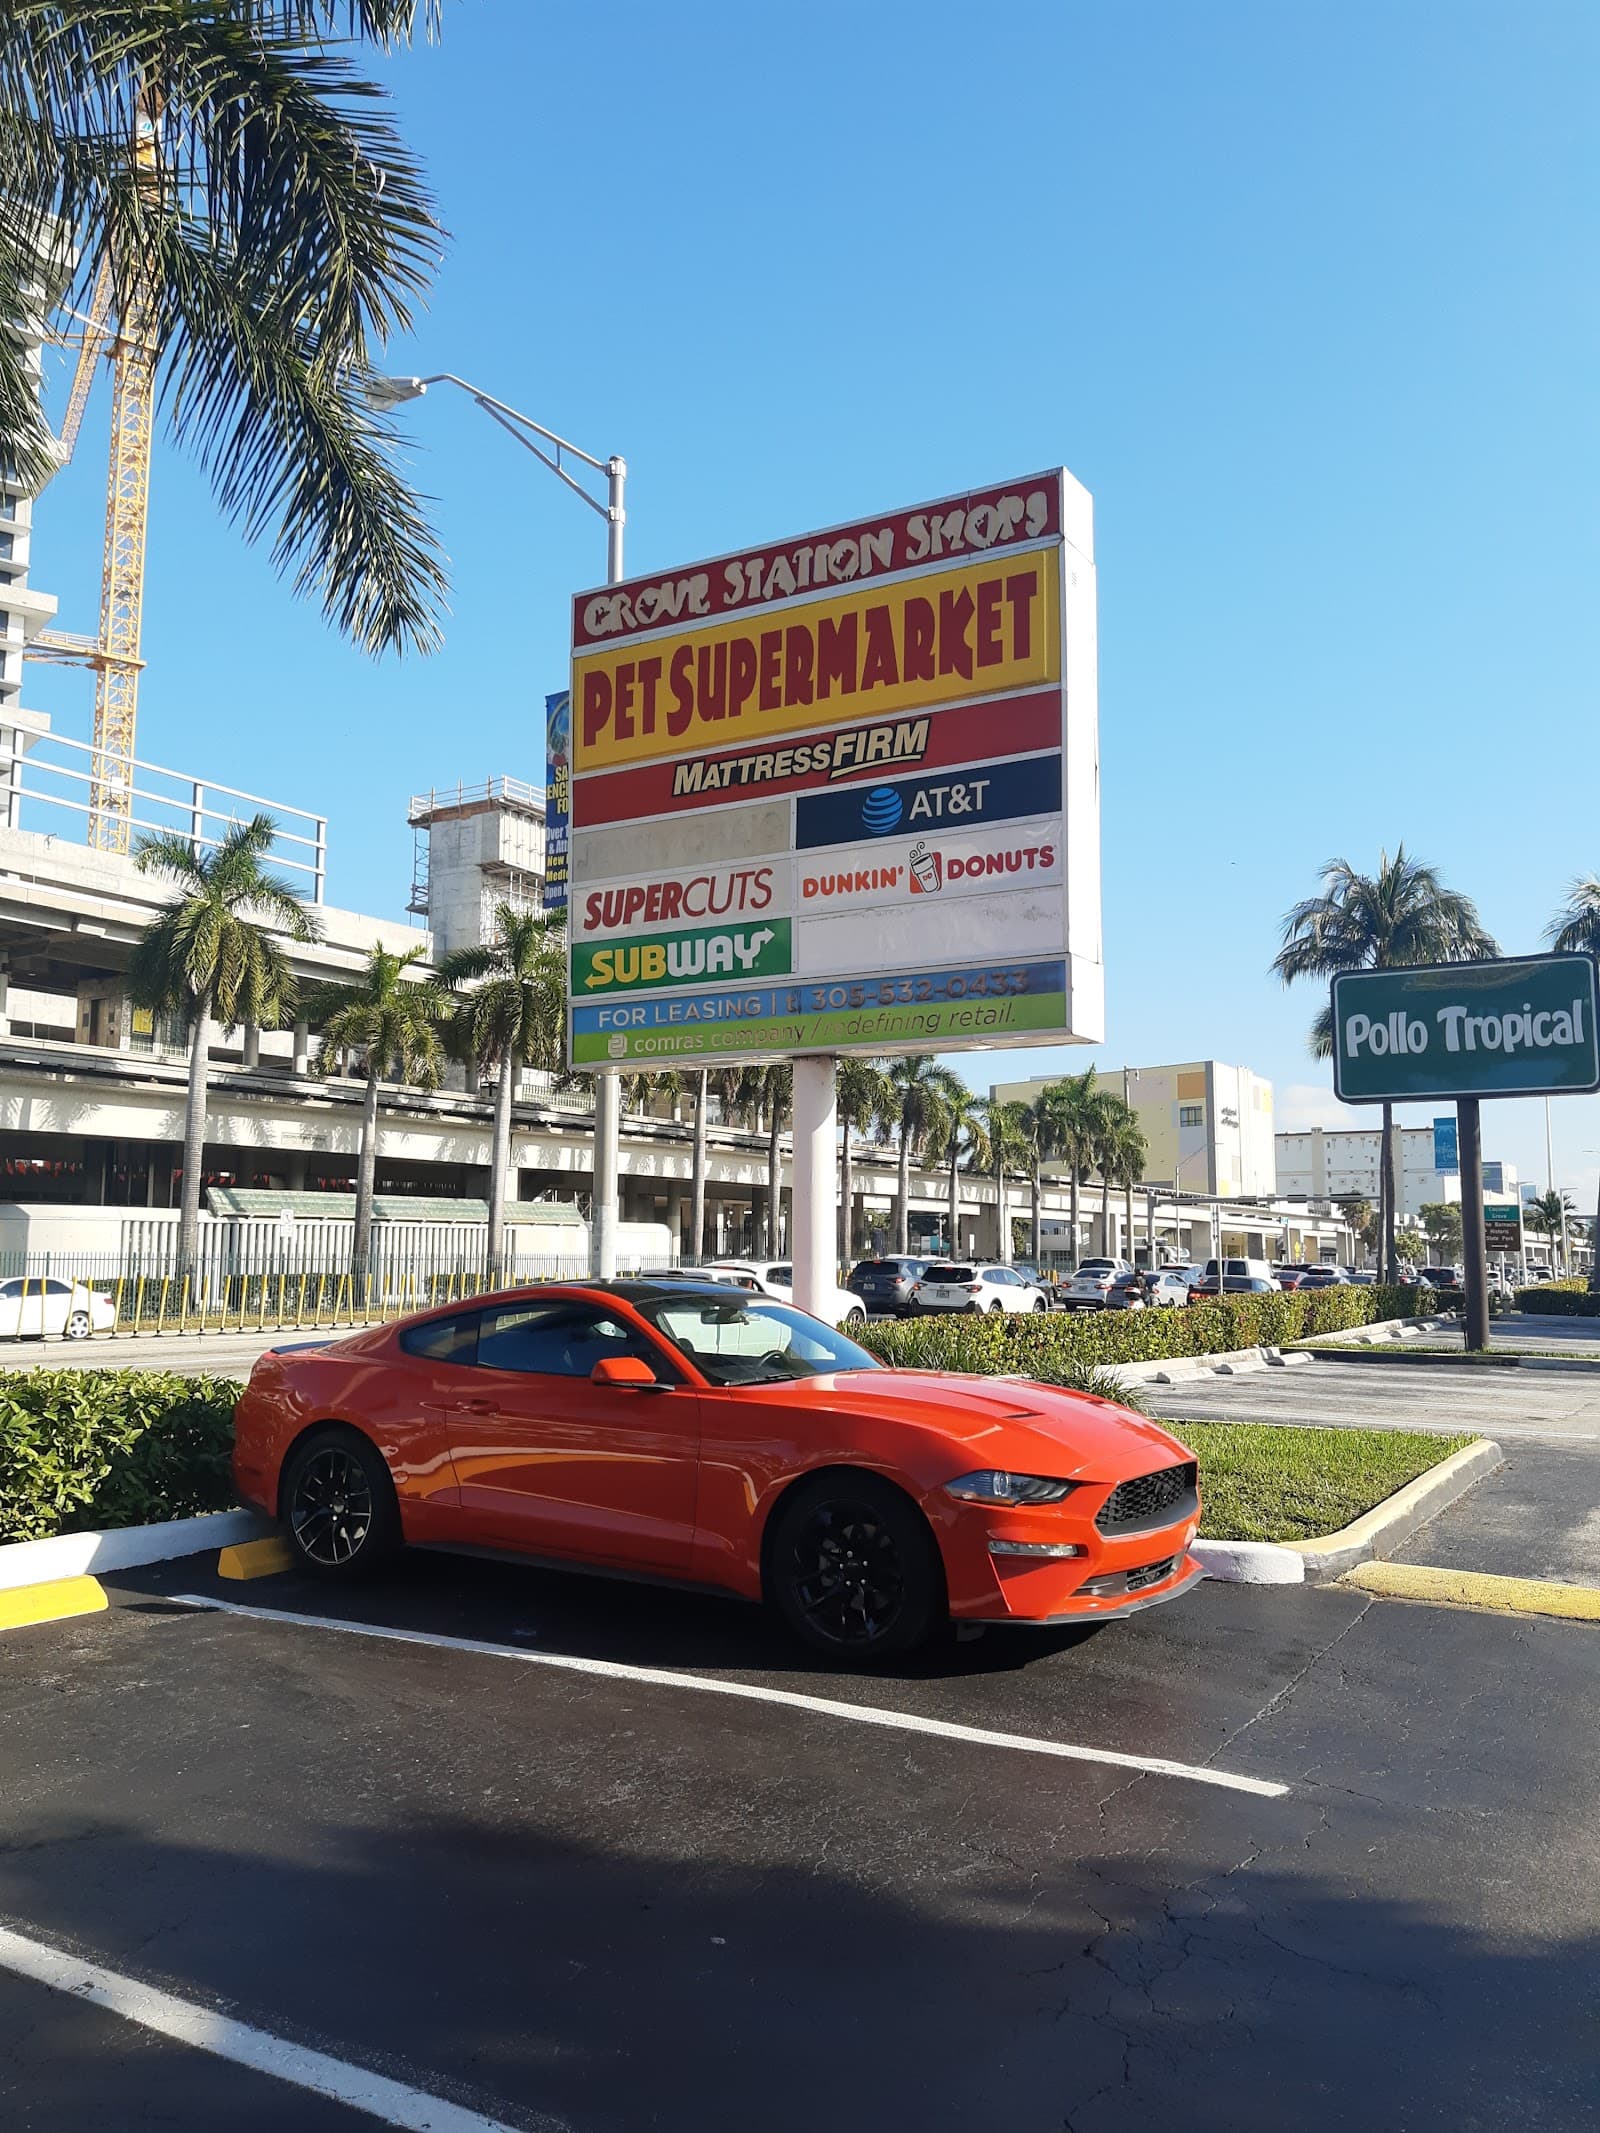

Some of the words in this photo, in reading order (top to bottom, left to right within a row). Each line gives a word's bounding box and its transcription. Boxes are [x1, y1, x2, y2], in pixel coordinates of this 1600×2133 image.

[583, 573, 711, 636] GROVE
[723, 527, 895, 606] STATION
[906, 491, 1049, 561] SHOPS
[909, 780, 990, 821] AT&T
[583, 867, 773, 930] SUPERCUTS
[803, 865, 904, 898] DUNKIN'
[947, 845, 1054, 880] DONUTS
[584, 927, 775, 989] SUBWAY
[598, 1007, 646, 1028] FOR
[655, 996, 761, 1023] LEASING
[811, 969, 1029, 1010] 305-532-0433
[634, 1031, 704, 1053] comras
[711, 1023, 806, 1047] company
[949, 1002, 1016, 1027] retail.
[1346, 1013, 1428, 1057] Pollo
[1437, 999, 1584, 1053] Tropical
